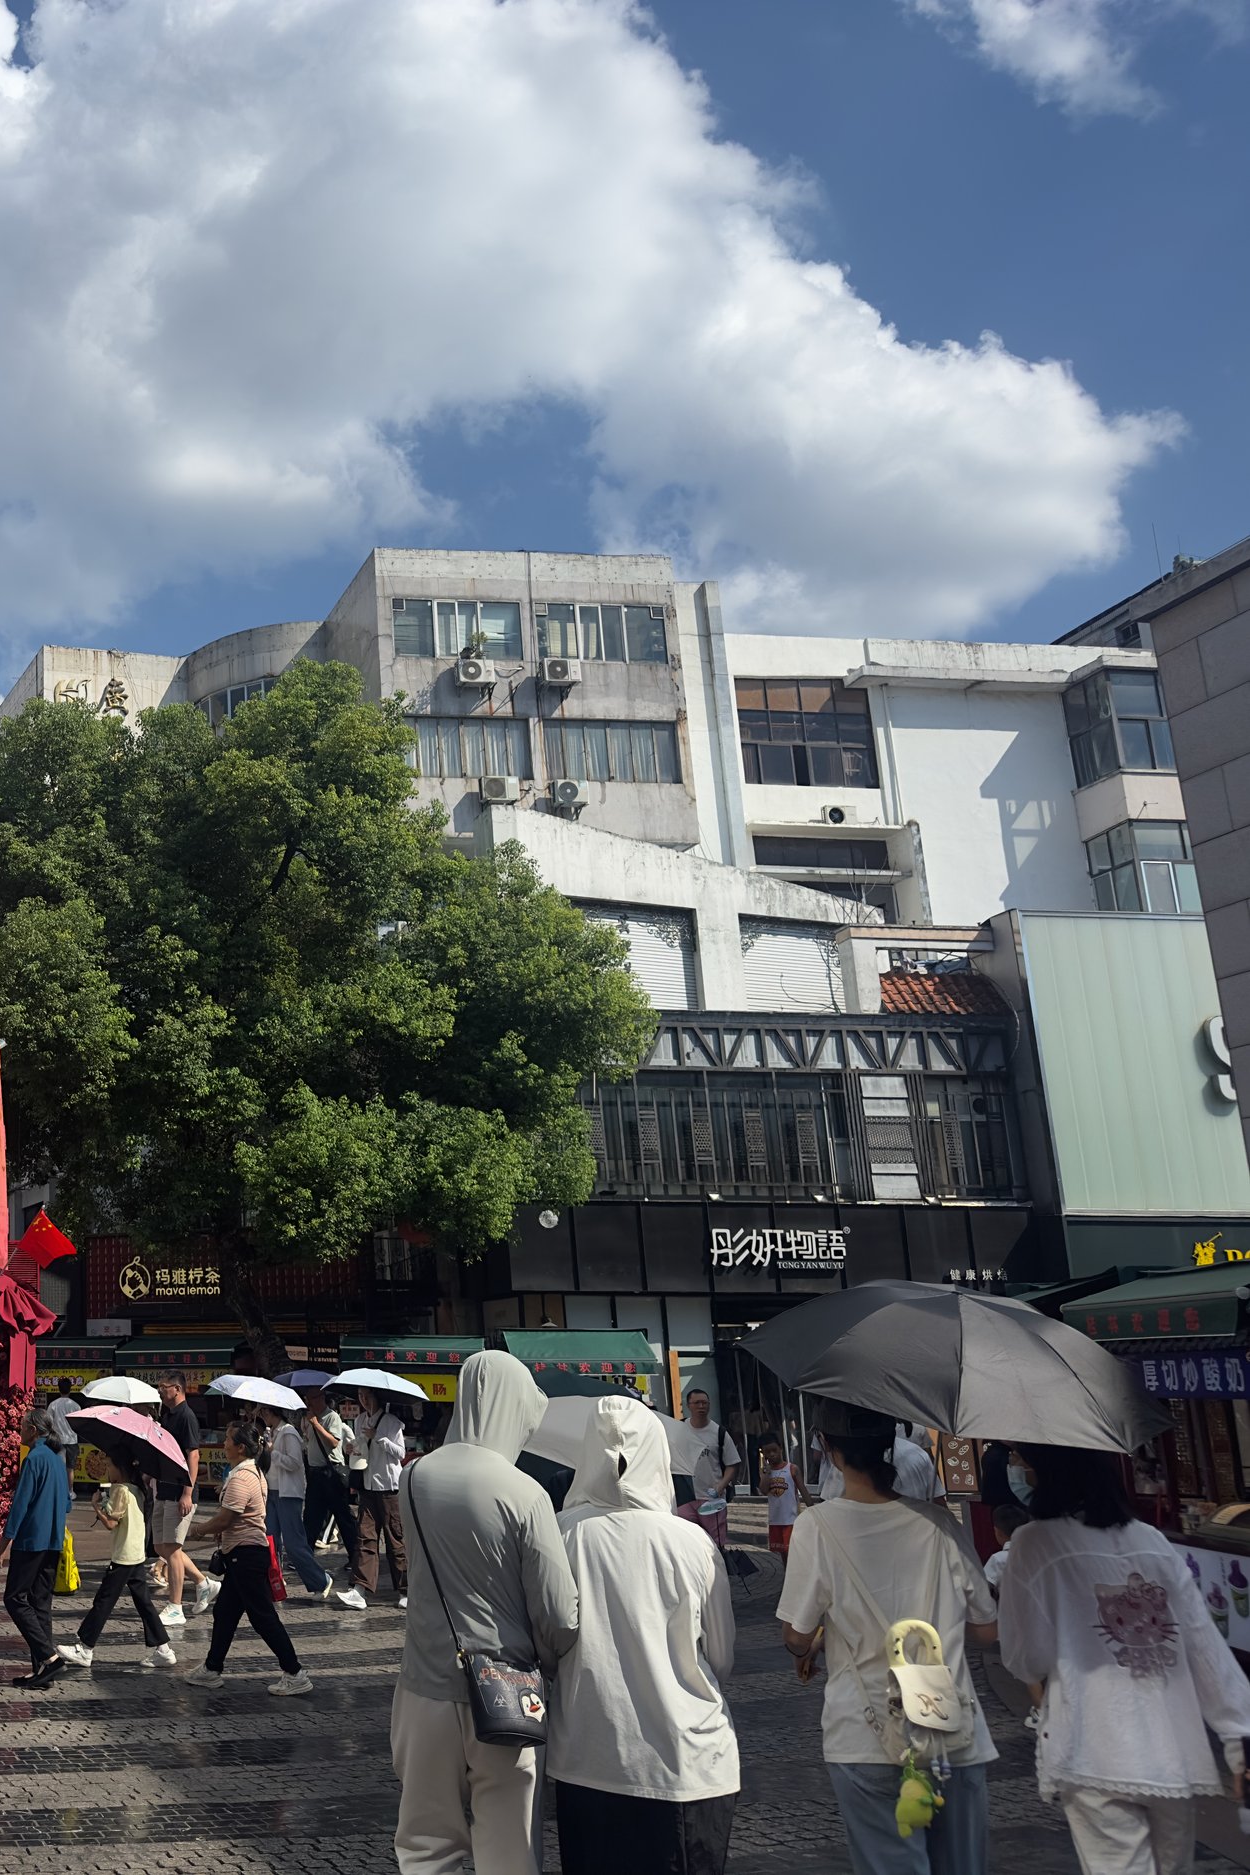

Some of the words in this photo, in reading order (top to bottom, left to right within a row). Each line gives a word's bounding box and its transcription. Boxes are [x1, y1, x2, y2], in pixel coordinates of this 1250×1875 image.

[155, 1267, 221, 1285] 玛雅柠茶
[364, 1350, 460, 1363] 桂林欢迎您
[1142, 1357, 1245, 1393] 厚切炒酸奶
